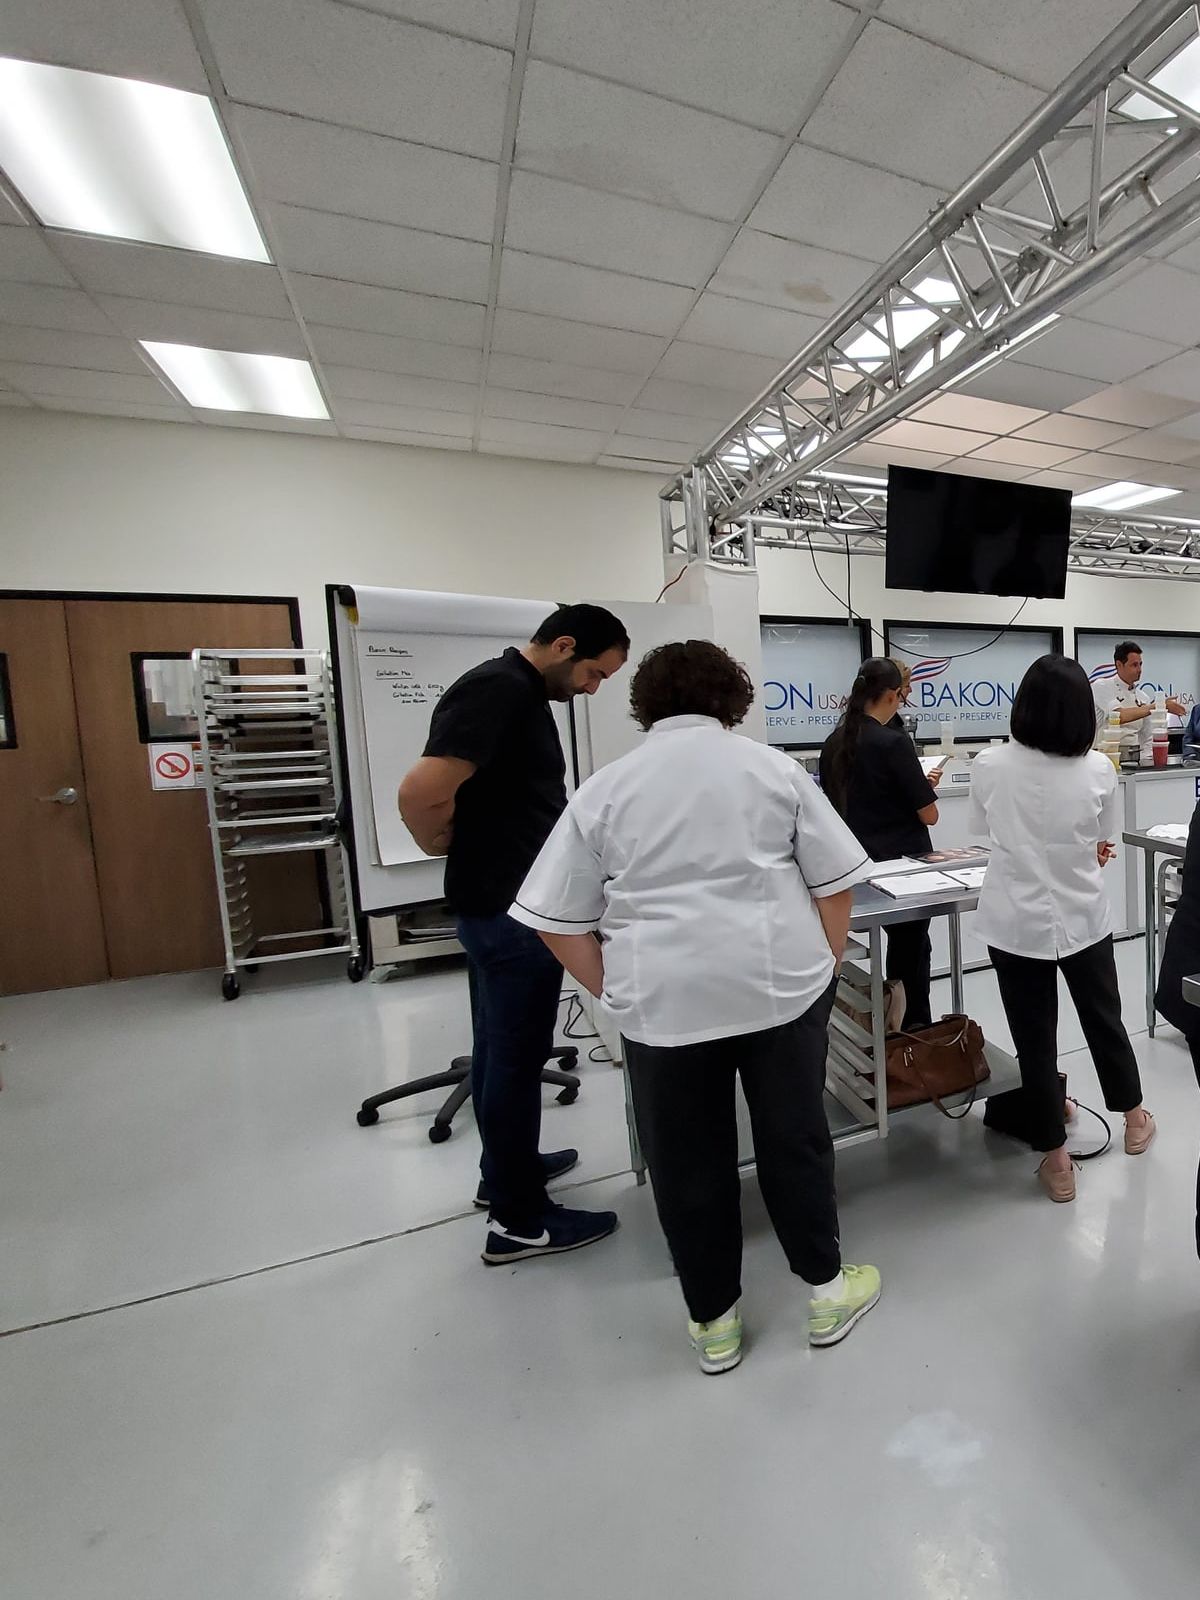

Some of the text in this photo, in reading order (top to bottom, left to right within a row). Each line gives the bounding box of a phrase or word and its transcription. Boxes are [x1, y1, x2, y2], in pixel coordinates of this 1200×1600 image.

[921, 681, 1017, 708] BAKON
[766, 716, 797, 726] ERVE
[914, 712, 1002, 721] ODUCE PRESERVE
